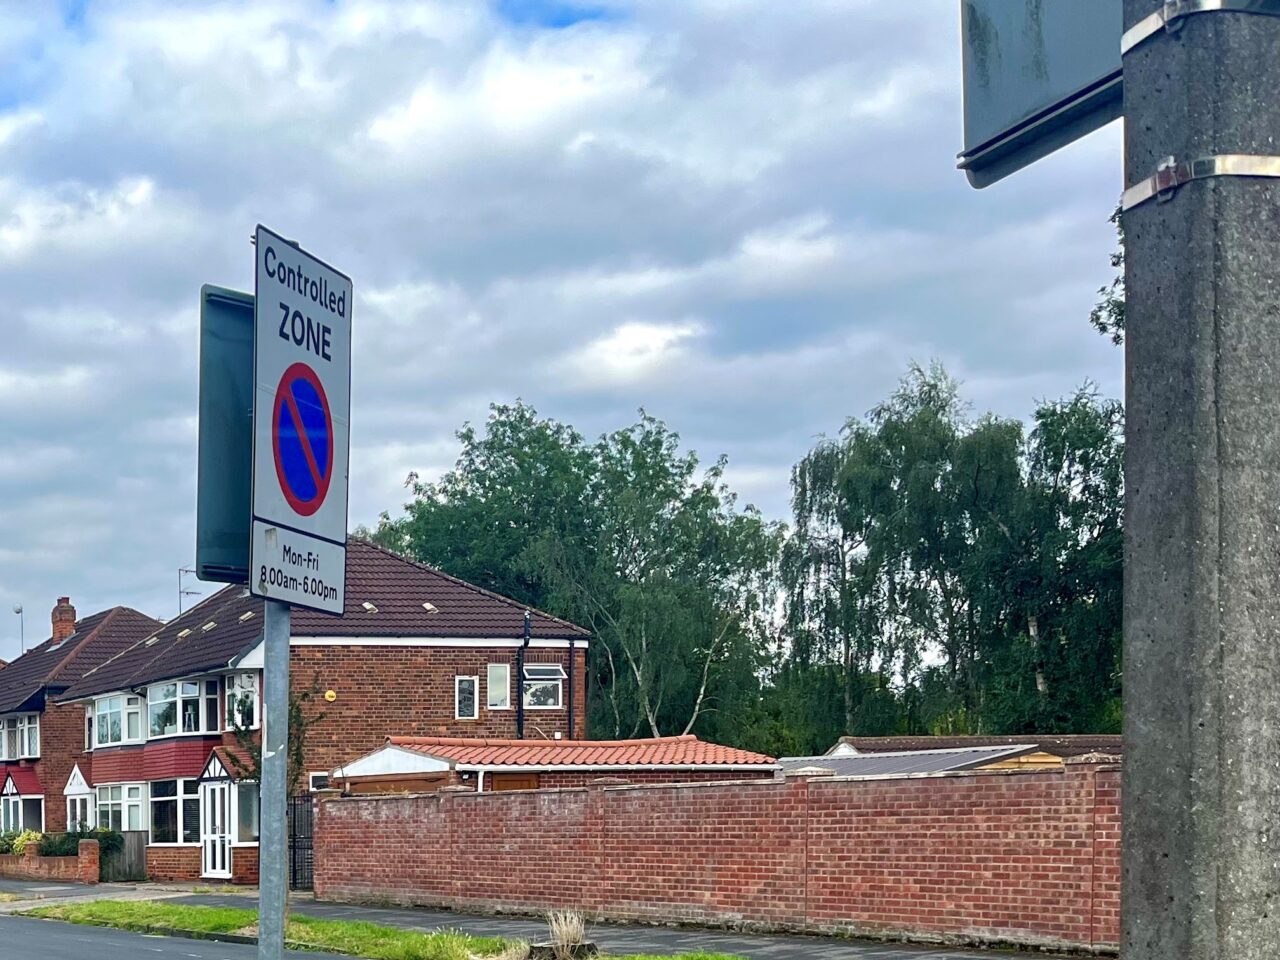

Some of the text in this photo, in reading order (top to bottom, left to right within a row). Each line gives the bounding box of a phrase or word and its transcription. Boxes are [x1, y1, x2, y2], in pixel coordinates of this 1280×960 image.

[264, 246, 346, 319] Controlled
[279, 301, 332, 363] ZONE
[282, 544, 320, 572] Mon-Fri
[260, 565, 338, 602] 8.00am-6.00pm
